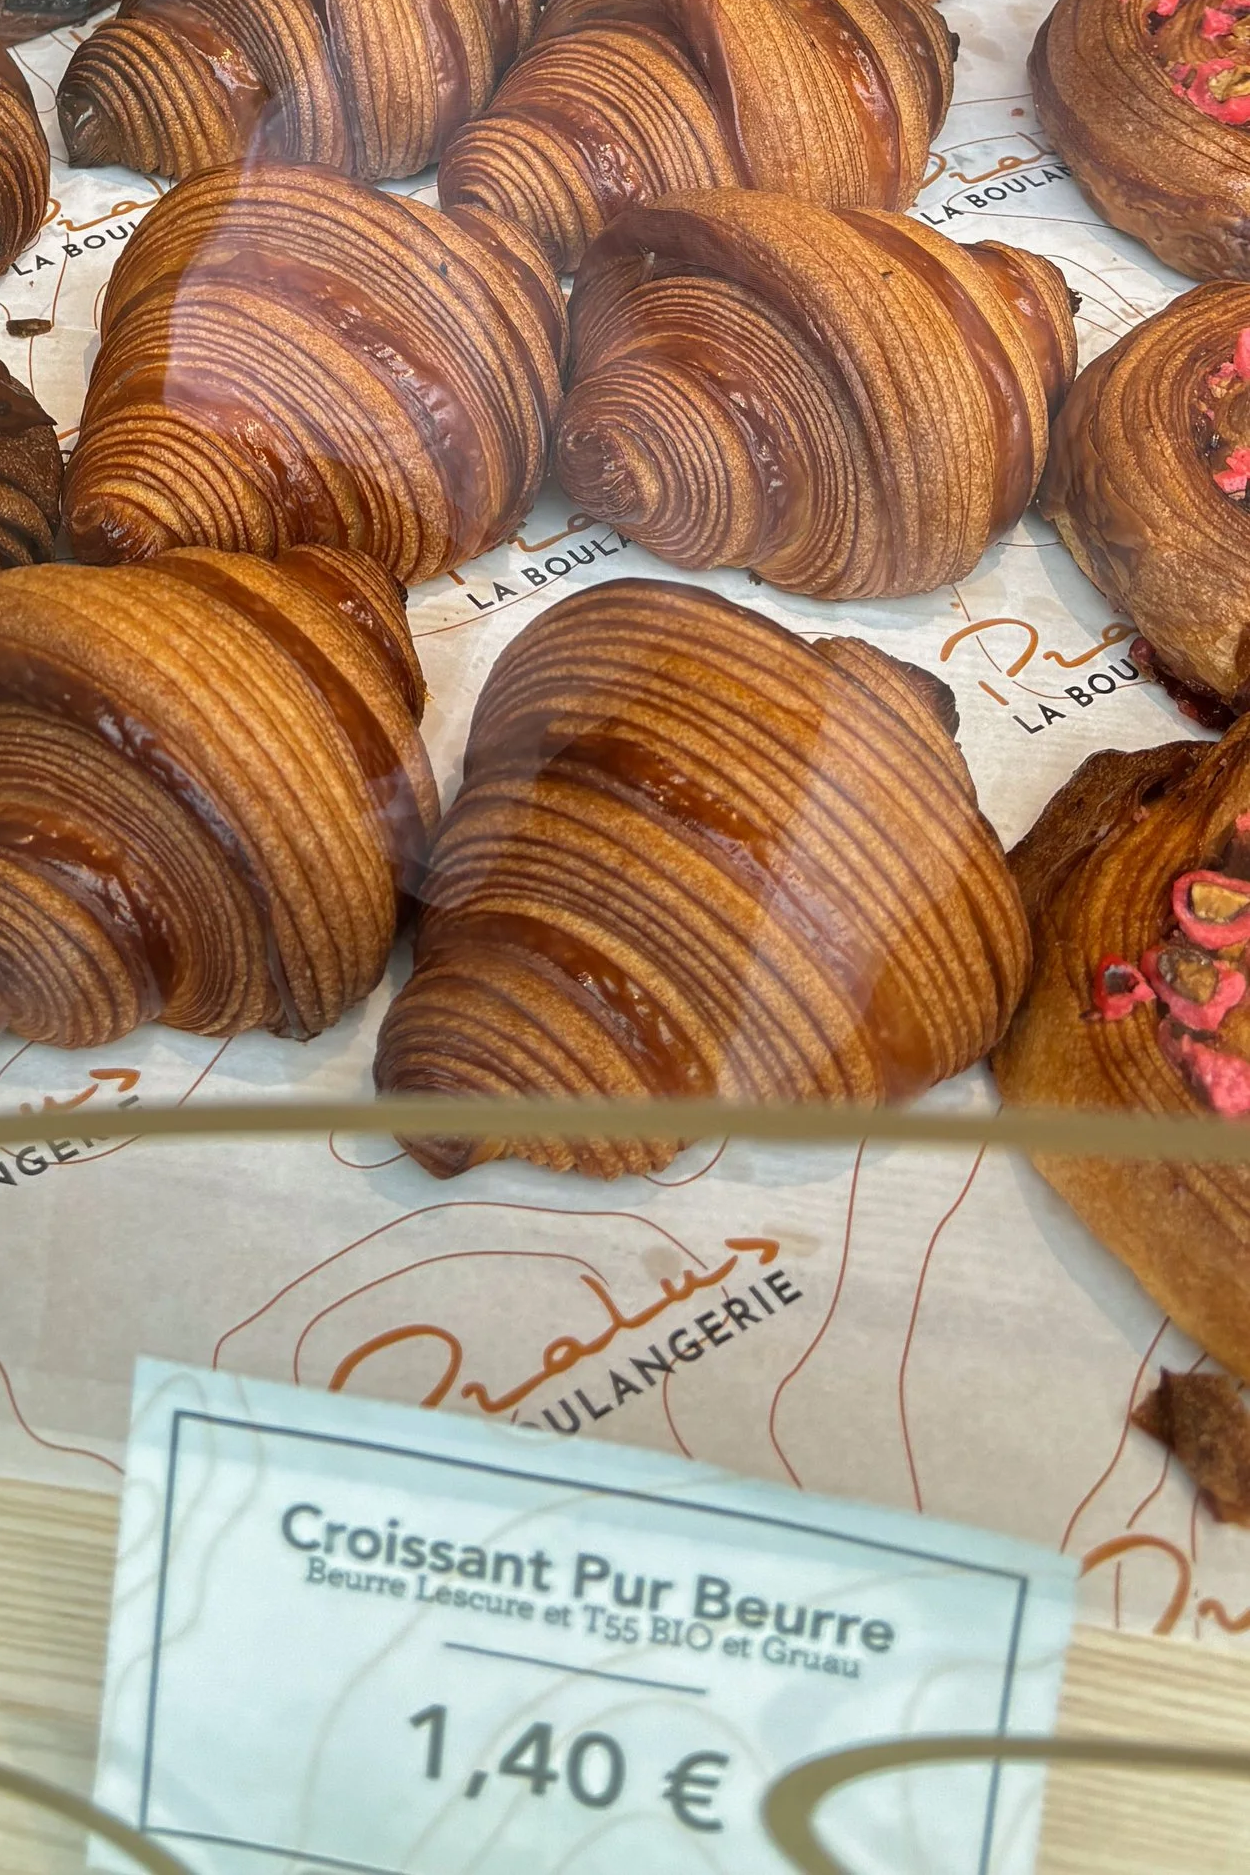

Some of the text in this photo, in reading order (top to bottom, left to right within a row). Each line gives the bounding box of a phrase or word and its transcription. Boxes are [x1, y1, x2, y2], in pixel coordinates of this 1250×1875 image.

[10, 221, 137, 276] LA BOU
[920, 204, 965, 226] LA
[466, 581, 519, 611] LA
[1012, 702, 1067, 735] LA
[516, 1268, 804, 1437] ULANGERIE
[280, 1501, 895, 1655] Croissant Pur Beurre
[305, 1555, 863, 1681] Beurre Lescure et T55 BIO et Gruau
[407, 1700, 732, 1834] 1,40 €
